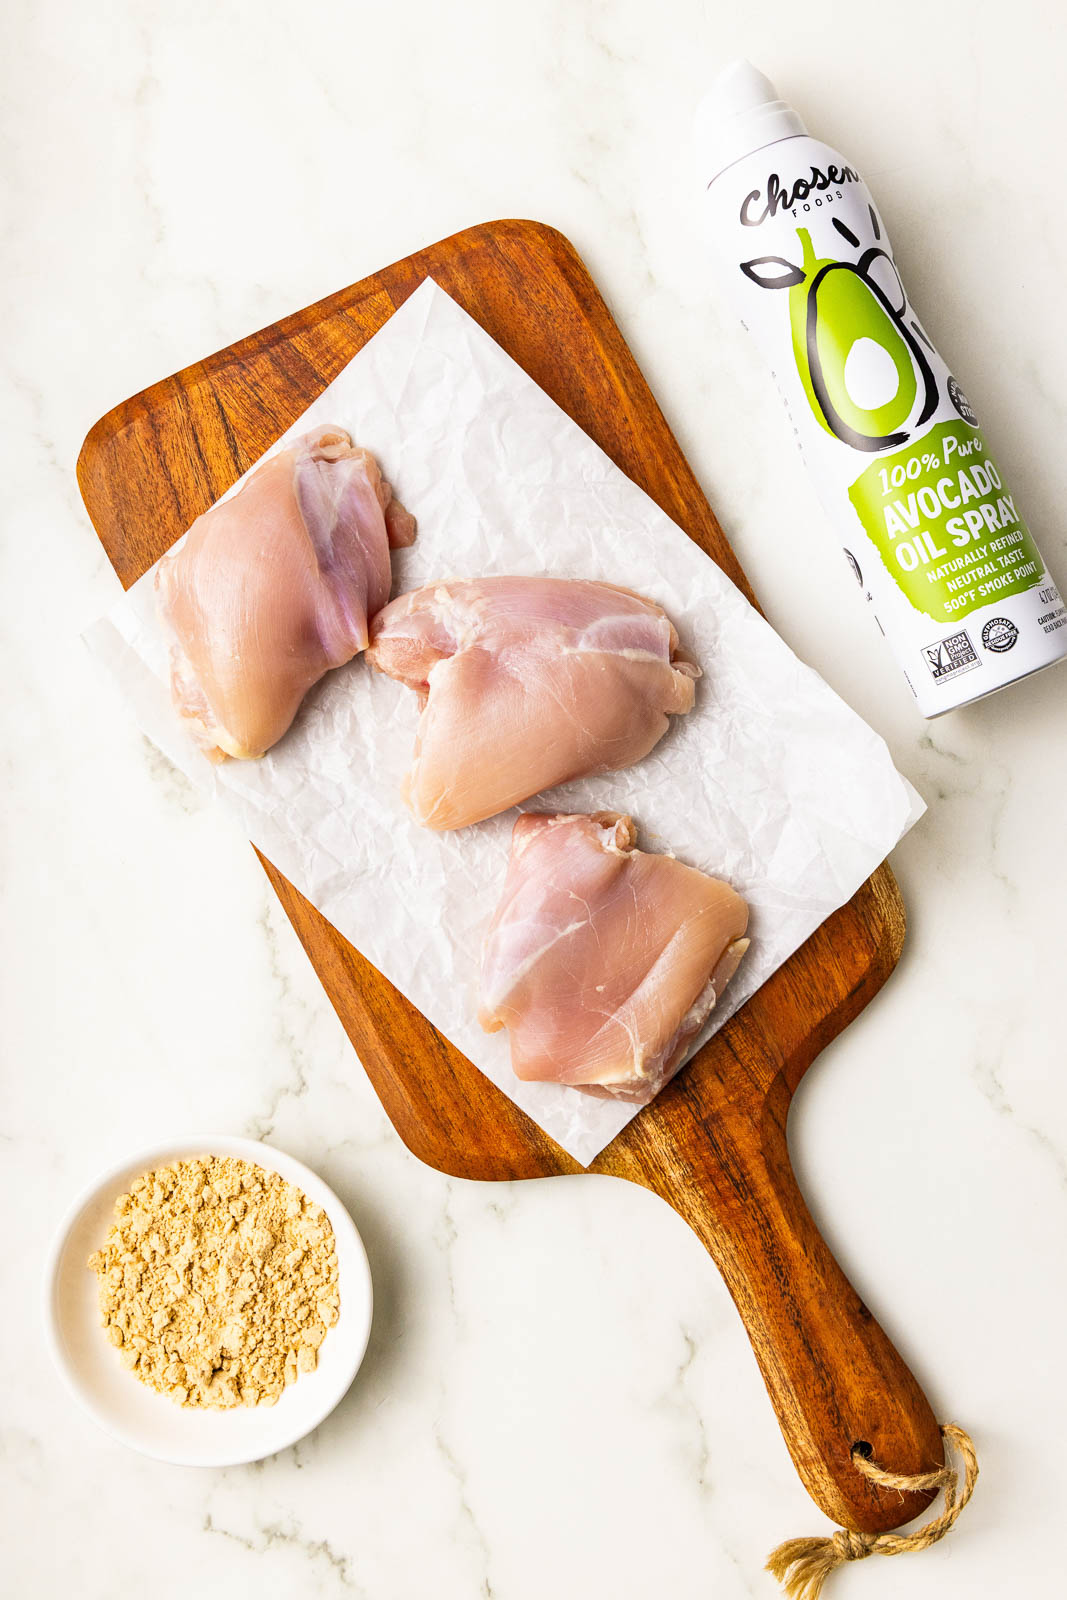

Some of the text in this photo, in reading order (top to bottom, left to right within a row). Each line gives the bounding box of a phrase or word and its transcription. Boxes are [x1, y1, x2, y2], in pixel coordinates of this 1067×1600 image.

[740, 165, 860, 226] Chosen
[792, 190, 843, 217] FOODS
[878, 435, 982, 496] 100% Pure
[883, 459, 1002, 540] AVOCADO
[895, 531, 948, 572] OIL
[945, 495, 1020, 548] SPRAY
[926, 530, 1024, 583] NATURALLY REFINED
[943, 561, 1038, 613] 500°F SMOKE POINT
[946, 548, 1025, 593] NEUTRAL TASTE
[934, 654, 975, 676] VERIFIED
[944, 634, 966, 648] NON
[948, 640, 969, 654] GMO
